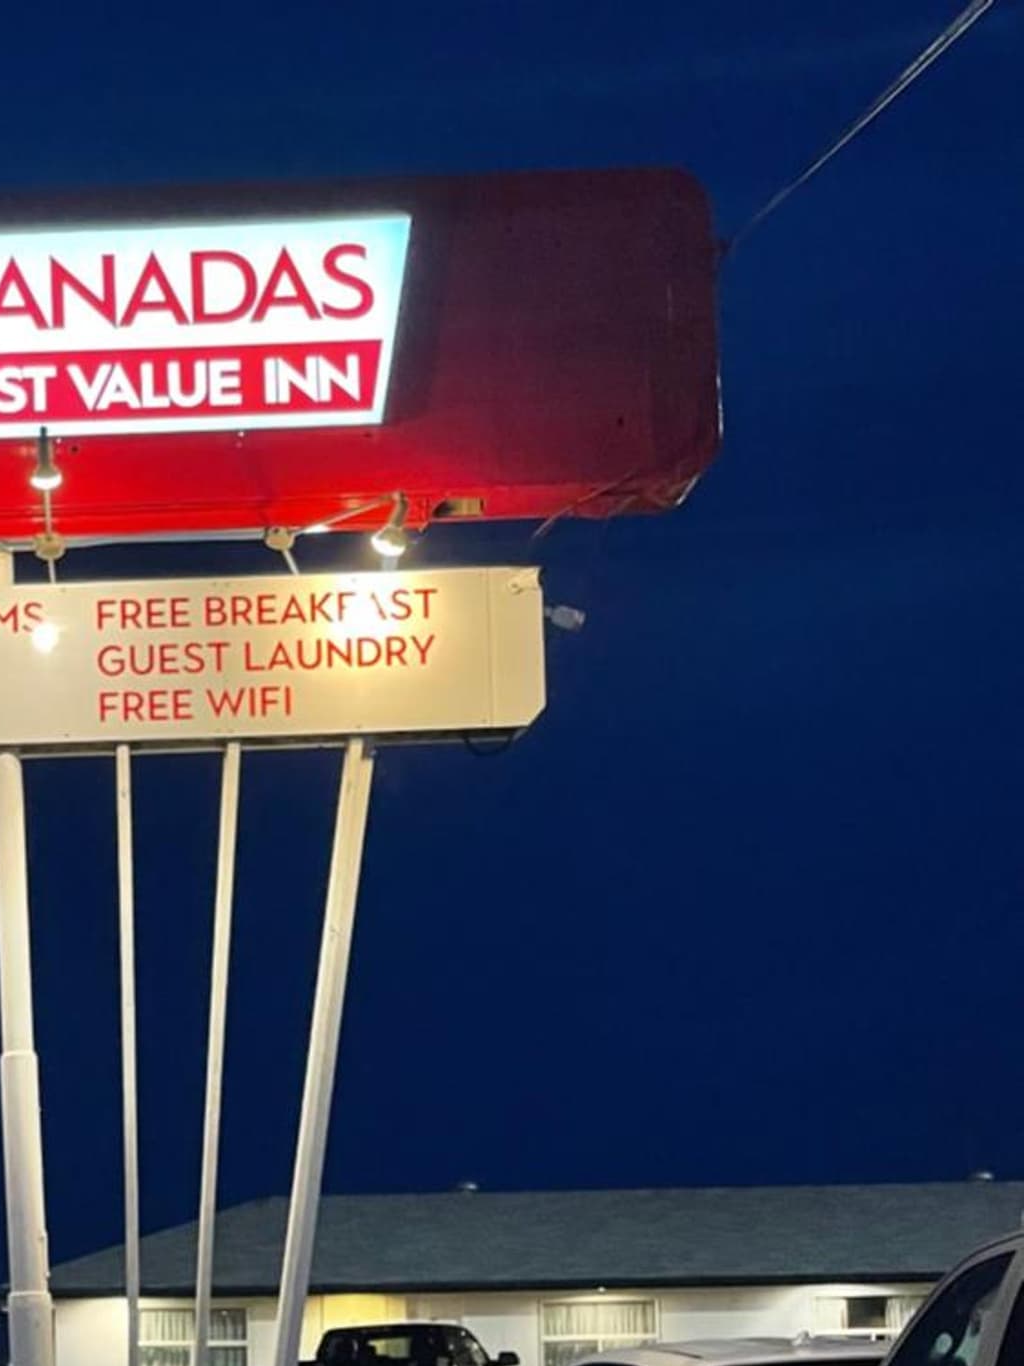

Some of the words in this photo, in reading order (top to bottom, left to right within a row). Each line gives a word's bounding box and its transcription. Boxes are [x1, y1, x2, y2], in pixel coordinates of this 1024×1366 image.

[66, 358, 243, 413] VALUE
[263, 354, 361, 405] INN
[95, 597, 191, 630] FREE
[96, 641, 231, 678] GUEST
[243, 634, 436, 673] LAUNDRY
[98, 689, 194, 723] FREE
[205, 686, 293, 719] WIFI
